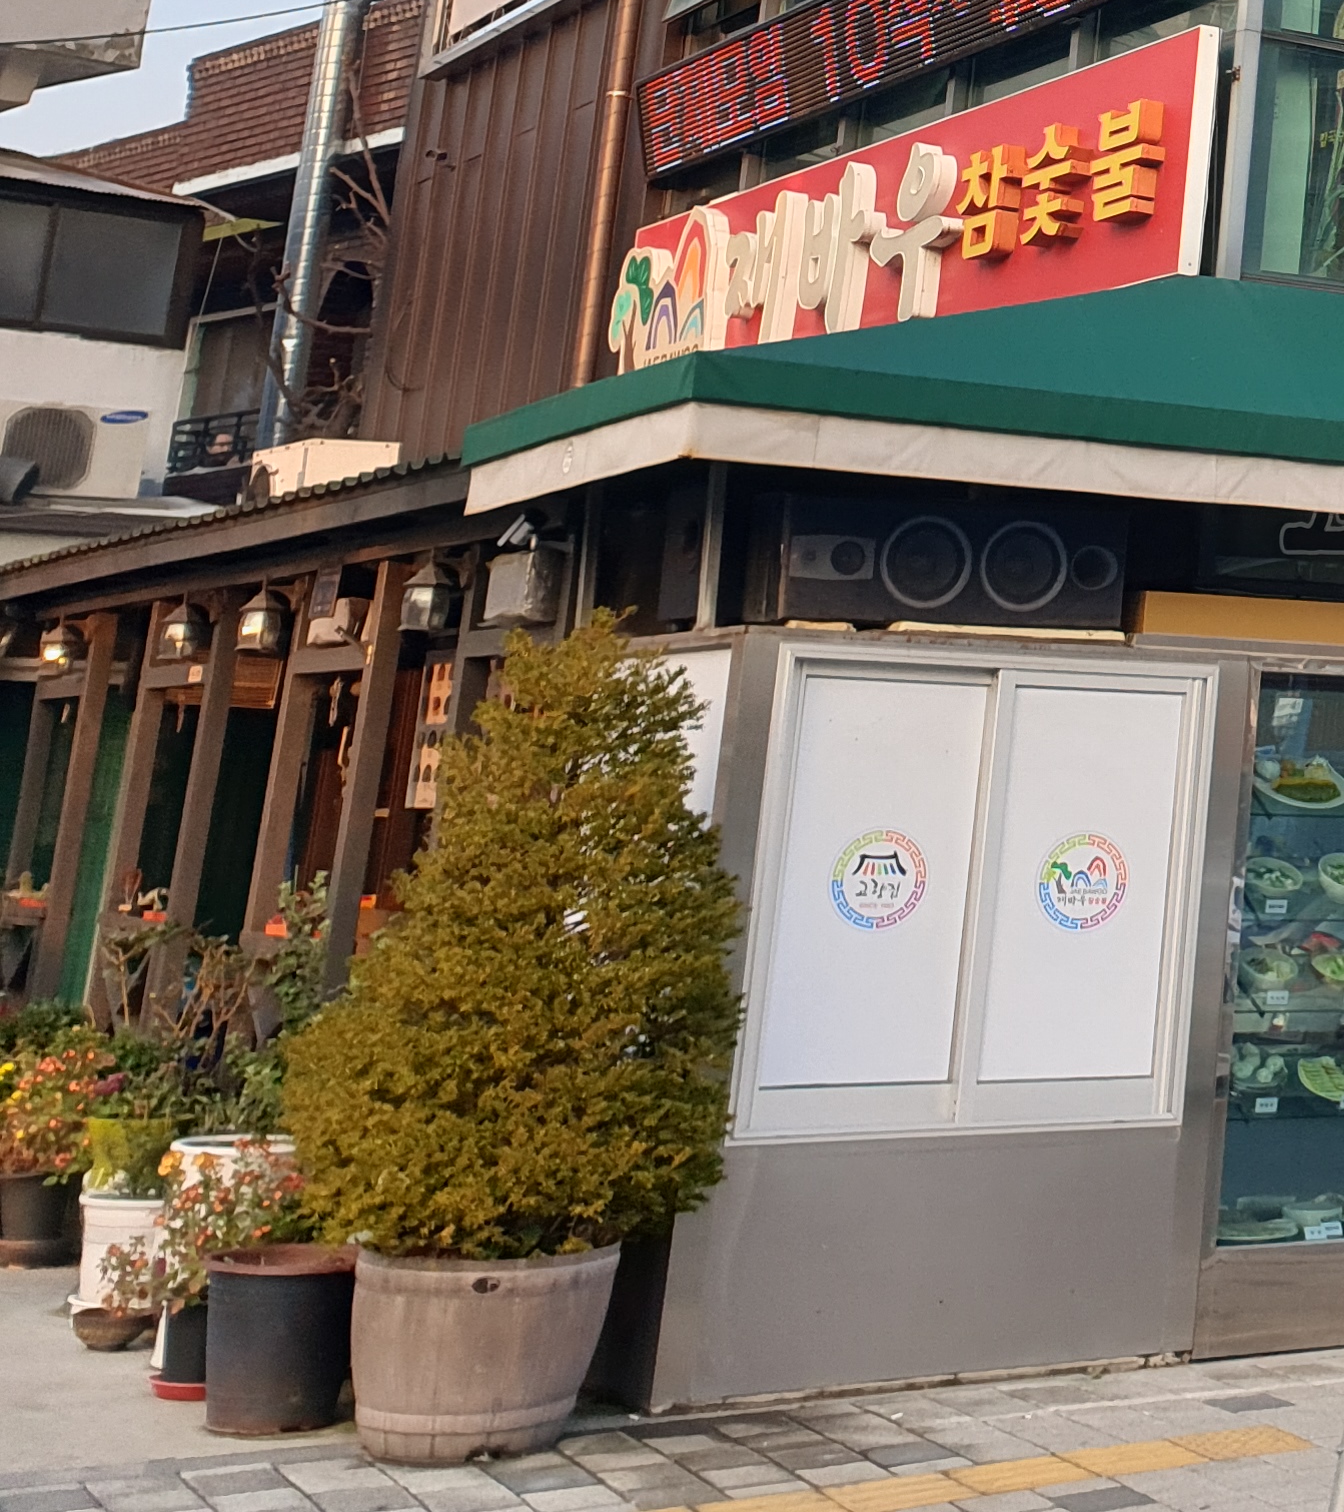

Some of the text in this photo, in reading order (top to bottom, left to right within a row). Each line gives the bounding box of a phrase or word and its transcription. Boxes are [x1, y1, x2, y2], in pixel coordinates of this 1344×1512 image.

[725, 98, 1165, 344] 재바우 참숯불
[855, 878, 901, 901] 고향집
